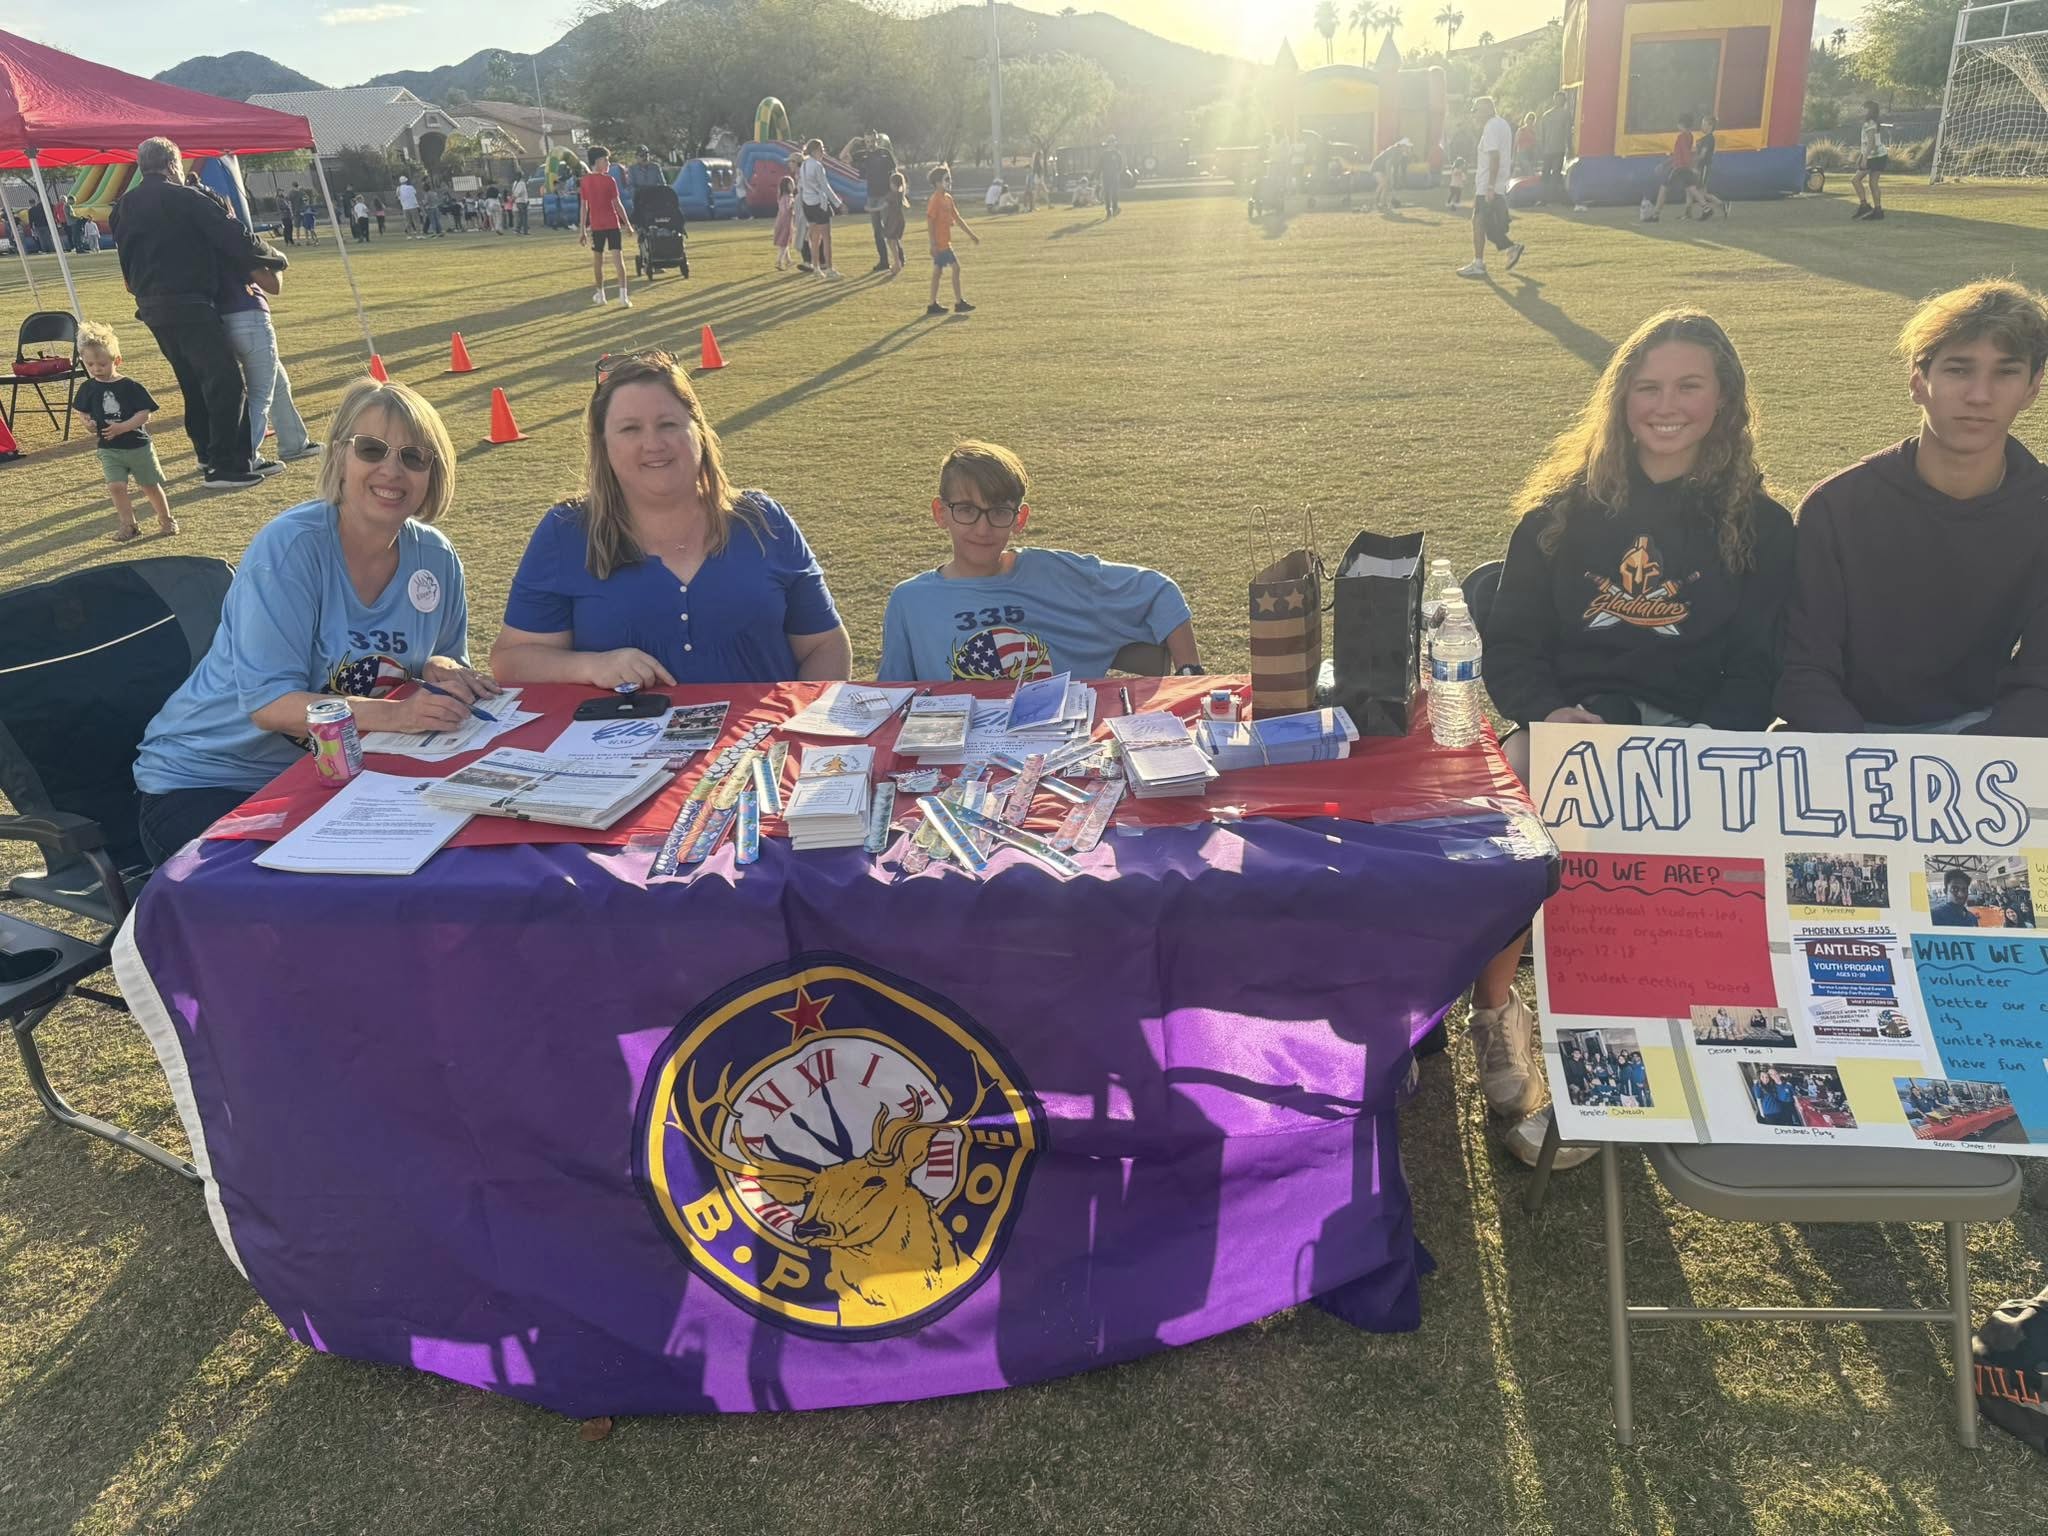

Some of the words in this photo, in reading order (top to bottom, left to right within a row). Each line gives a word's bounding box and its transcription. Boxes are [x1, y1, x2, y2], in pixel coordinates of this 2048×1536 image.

[1583, 592, 1686, 618] Gladiators
[954, 605, 1025, 631] 335
[347, 630, 409, 654] 335
[592, 720, 663, 742] Elks
[1540, 737, 2030, 847] ANTLERS
[1613, 862, 1647, 881] WE
[1664, 864, 1720, 885] ARE?
[1802, 927, 1840, 936] PHOENIX
[1843, 926, 1865, 935] ELKS
[1814, 943, 1881, 957] ANTLERS
[1915, 940, 1976, 961] WHAT
[1989, 944, 2024, 964] WE
[1814, 963, 1842, 971] YOUTH
[1844, 963, 1885, 973] PROGRAM
[1705, 980, 1751, 994] board
[1929, 973, 2012, 987] volunteer
[1932, 995, 1988, 1009] better
[2003, 1002, 2025, 1010] our
[1942, 1034, 1983, 1047] unite
[2000, 1037, 2043, 1049] make
[793, 1048, 838, 1098] XII
[1948, 1056, 1986, 1070] have
[1998, 1058, 2026, 1072] fun
[682, 1187, 733, 1242] B
[762, 1251, 810, 1293] P
